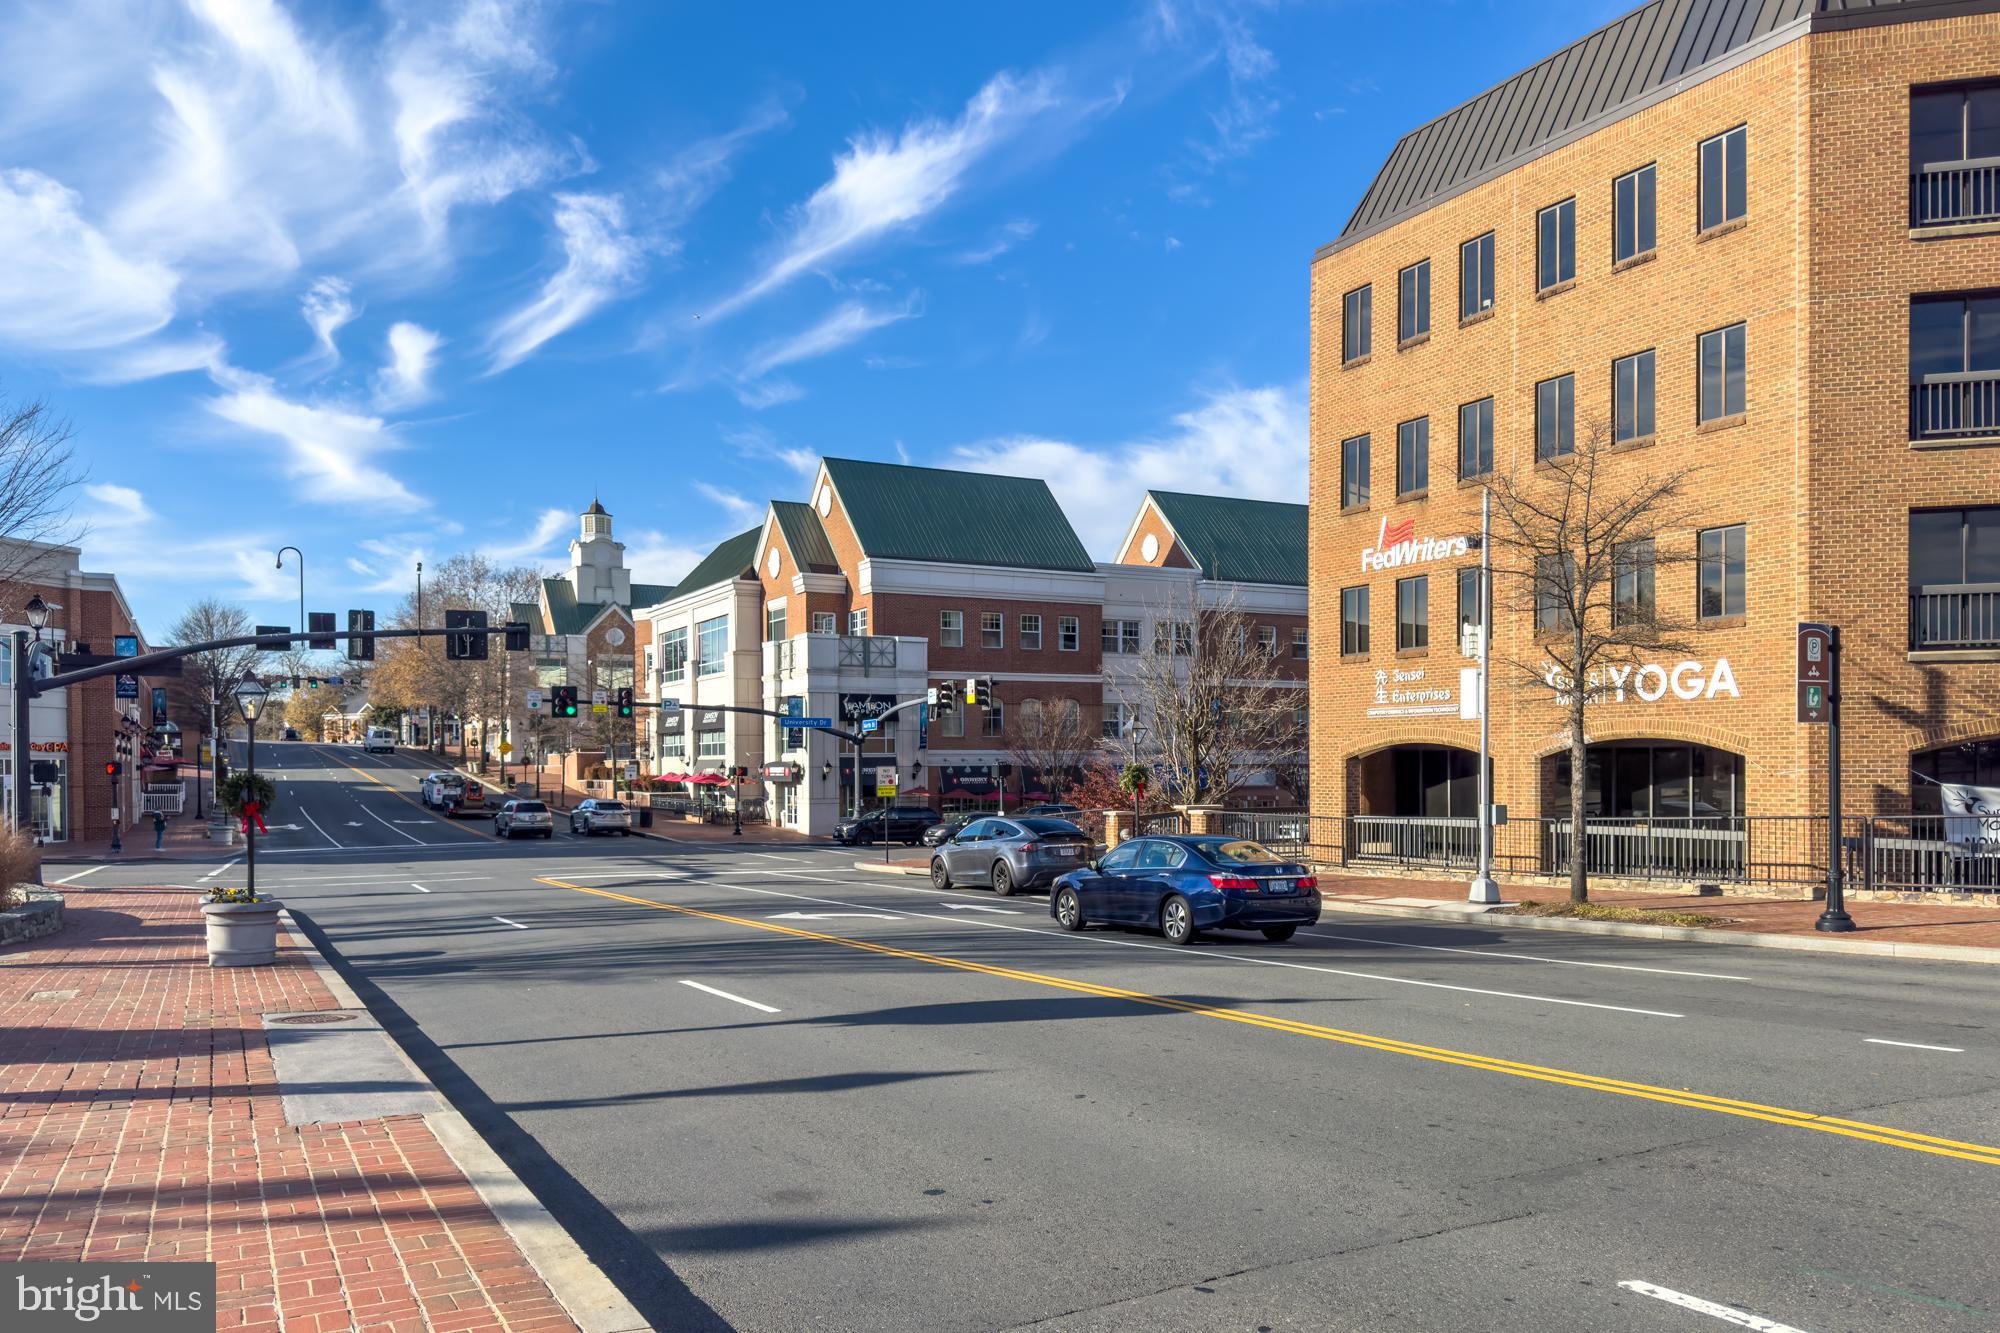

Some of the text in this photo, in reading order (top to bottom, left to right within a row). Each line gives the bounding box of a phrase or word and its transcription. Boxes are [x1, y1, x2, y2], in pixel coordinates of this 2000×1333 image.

[1362, 536, 1467, 573] FedWriters
[1393, 667, 1426, 682] Sensei
[1610, 658, 1740, 703] YOGA
[1393, 688, 1452, 704] Enterprises
